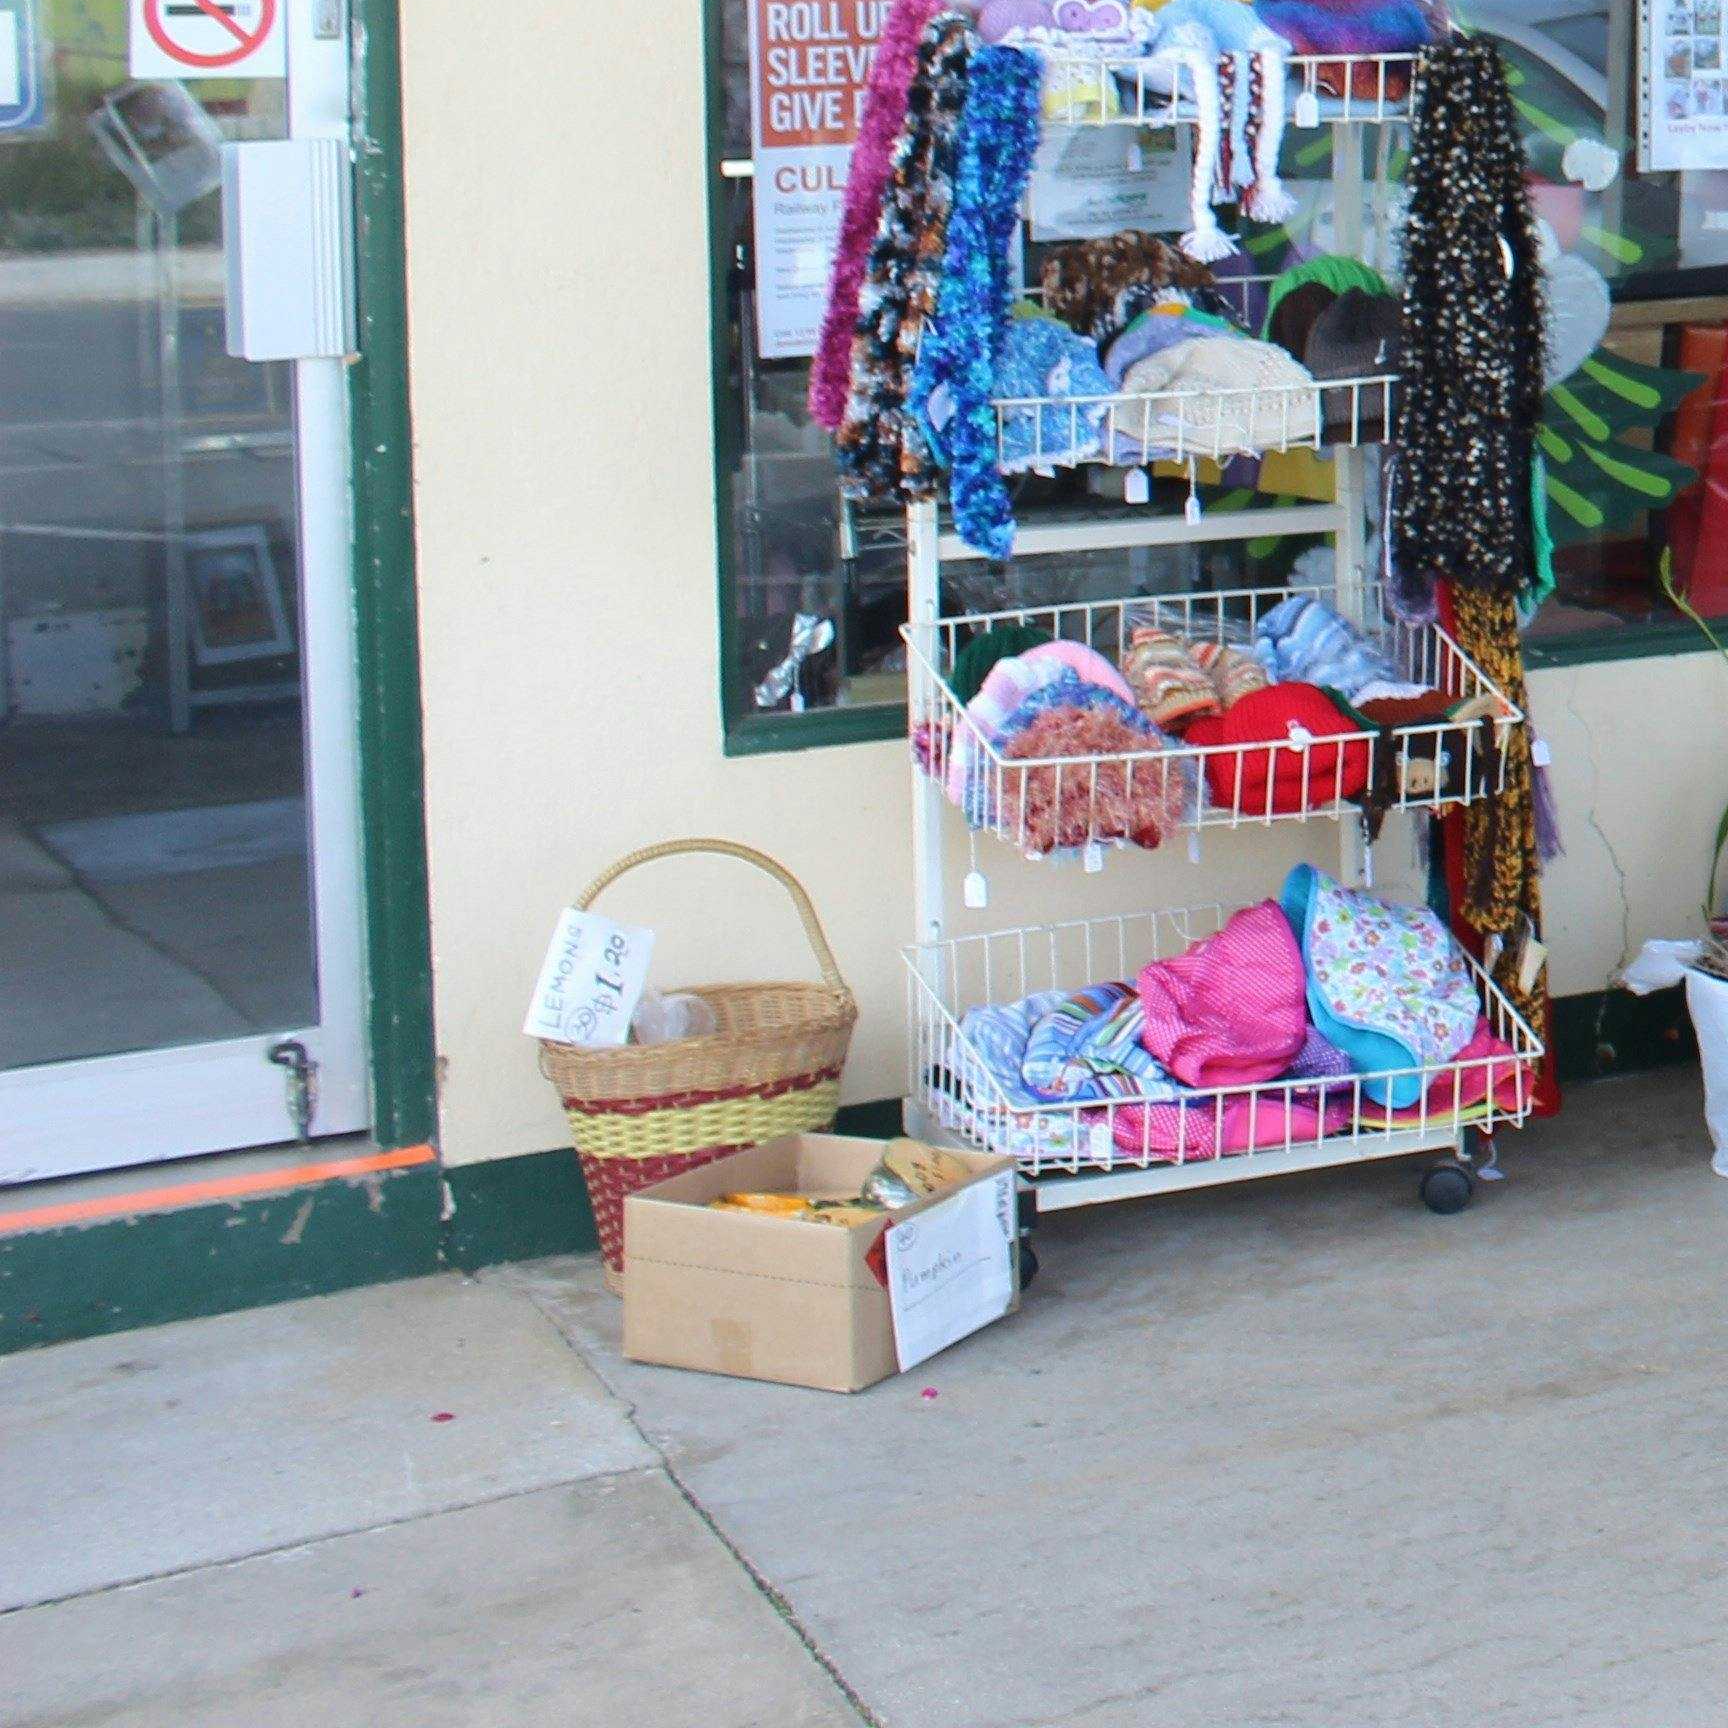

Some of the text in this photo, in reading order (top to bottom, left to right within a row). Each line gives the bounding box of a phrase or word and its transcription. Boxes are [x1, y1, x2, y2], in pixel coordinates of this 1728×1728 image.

[766, 0, 850, 42] ROLL
[769, 90, 846, 134] GIVE
[538, 924, 583, 1029] LEMONS
